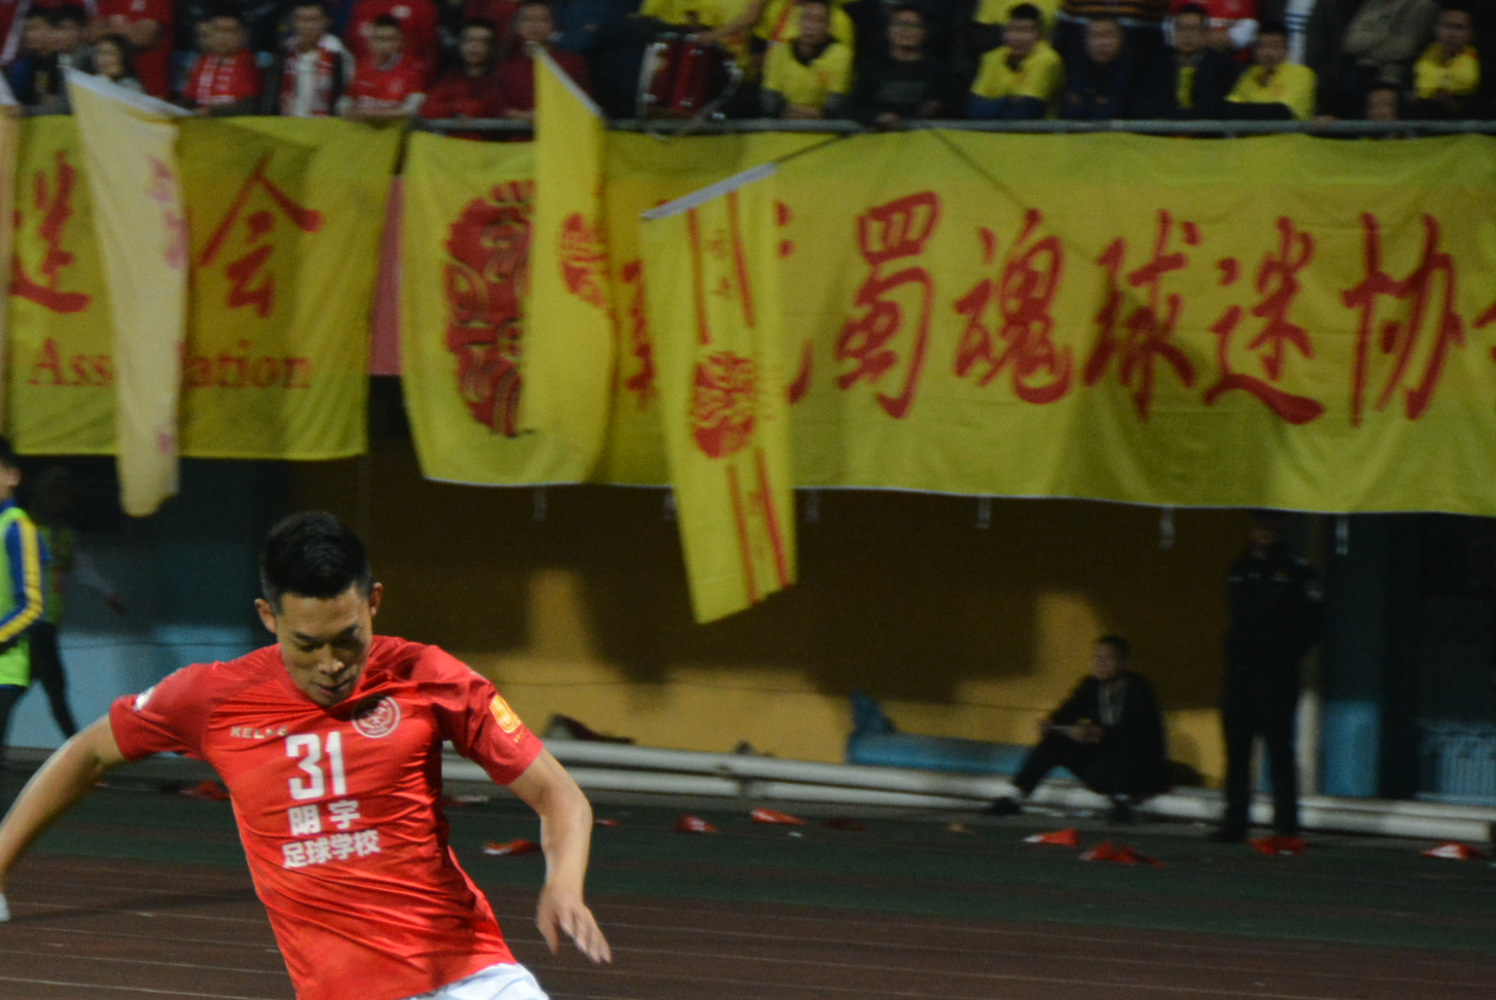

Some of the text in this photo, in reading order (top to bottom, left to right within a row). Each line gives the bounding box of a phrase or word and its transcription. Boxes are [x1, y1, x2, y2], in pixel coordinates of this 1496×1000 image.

[26, 337, 312, 390] Assation
[286, 731, 347, 800] 31
[287, 800, 361, 836] 明宇
[281, 829, 381, 869] 足球学校
